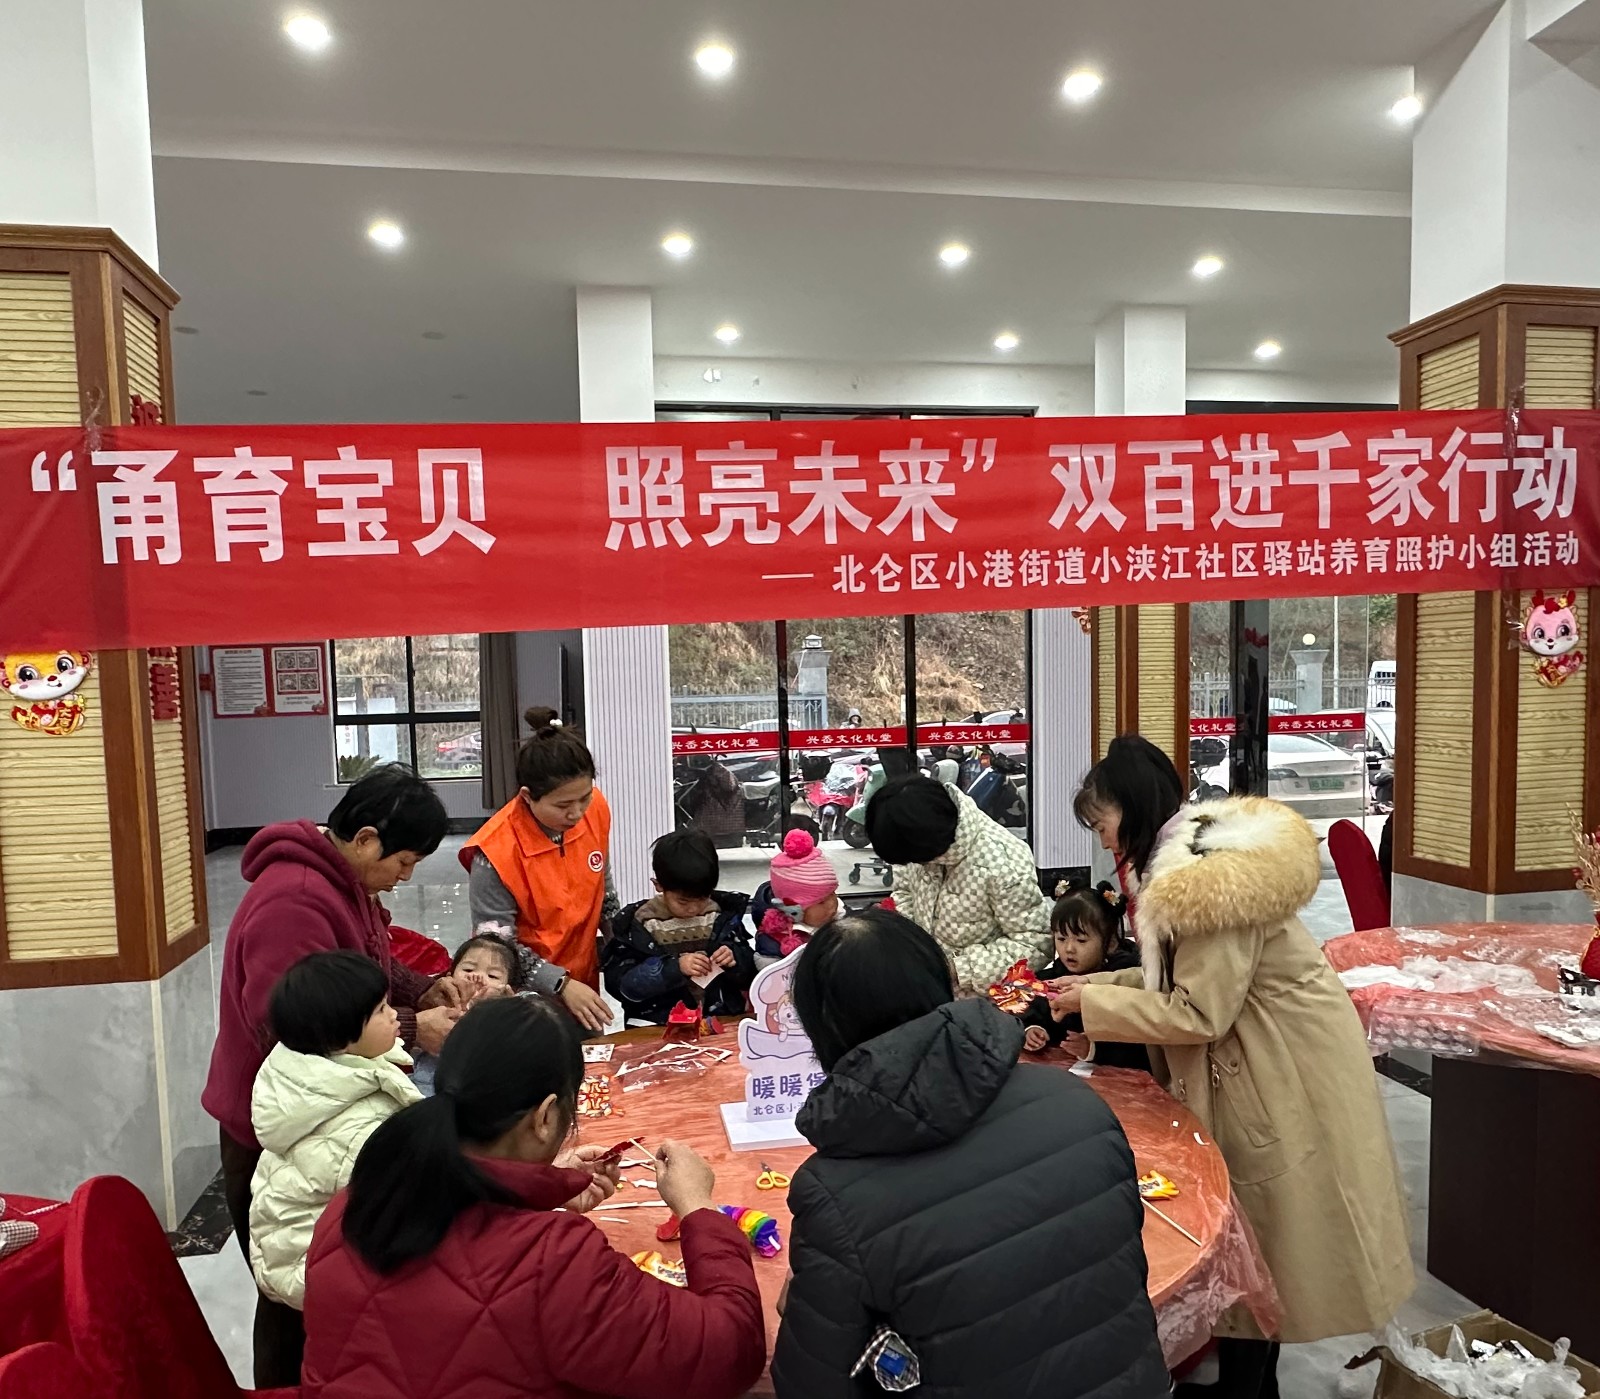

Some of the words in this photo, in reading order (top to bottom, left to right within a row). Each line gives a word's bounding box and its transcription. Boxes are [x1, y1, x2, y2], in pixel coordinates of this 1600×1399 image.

[31, 444, 497, 565] “甬育宝贝
[604, 437, 997, 551] 照亮未来”
[1048, 426, 1579, 533] 双百进千家行动
